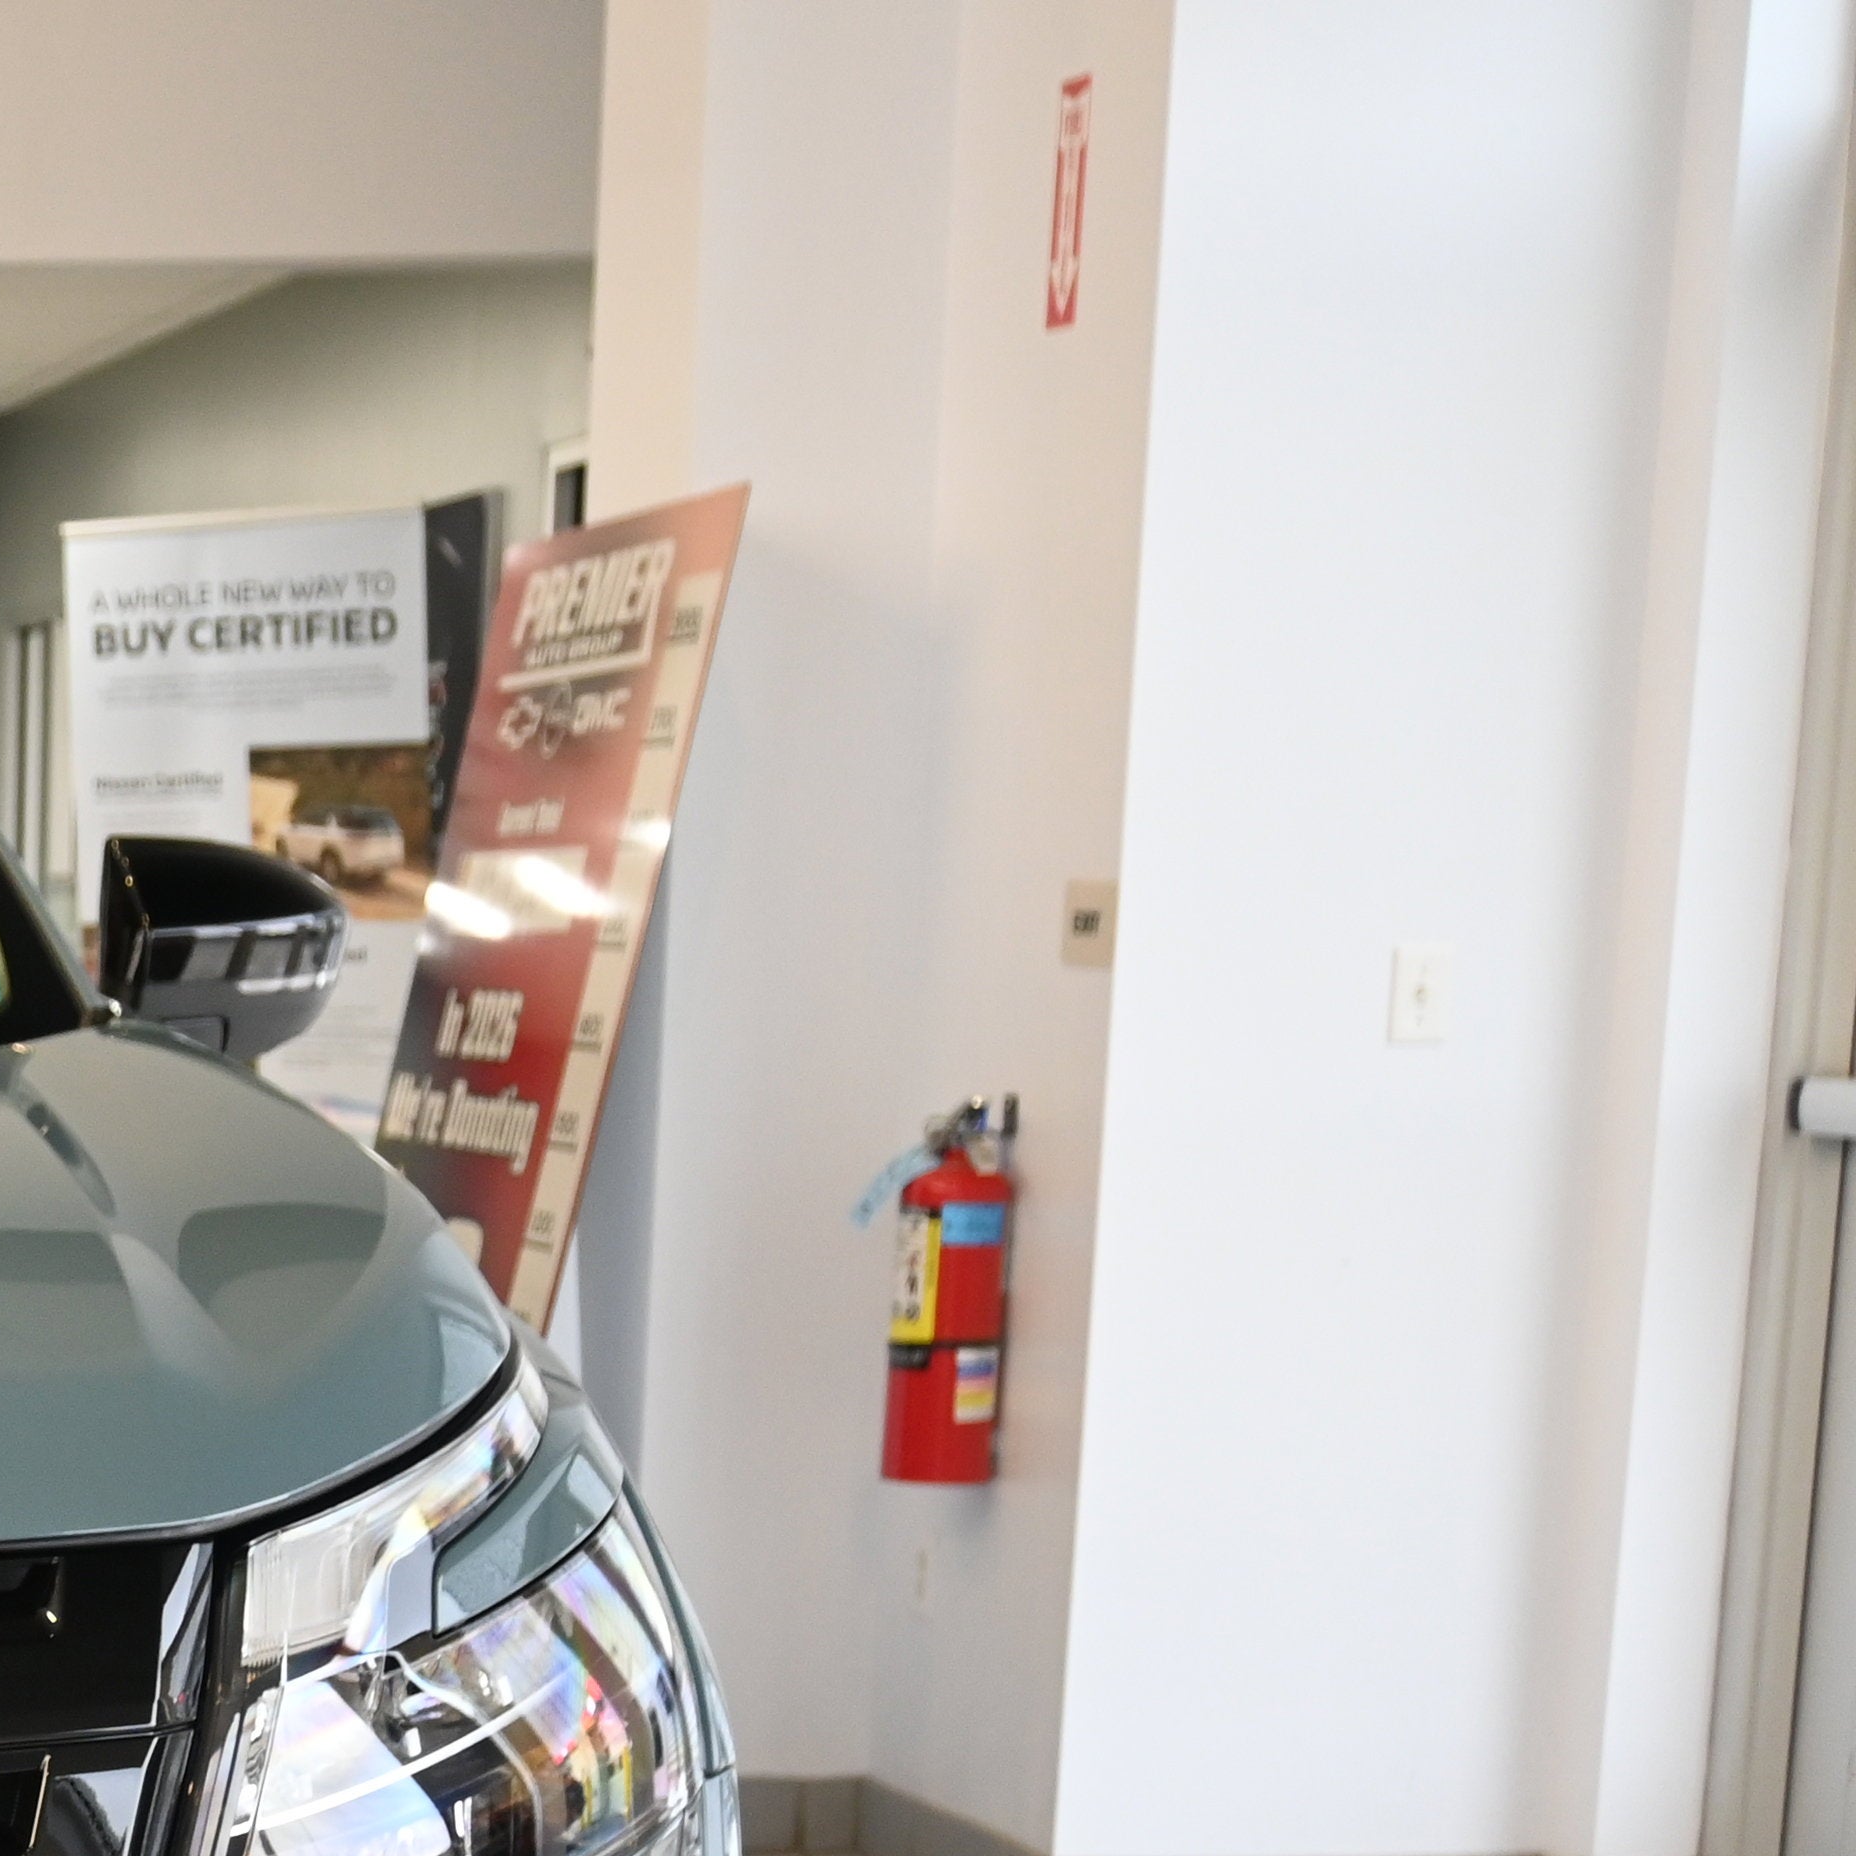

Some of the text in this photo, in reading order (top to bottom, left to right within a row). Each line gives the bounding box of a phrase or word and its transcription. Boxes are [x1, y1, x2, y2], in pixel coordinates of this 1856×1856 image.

[92, 571, 396, 611] A WHOLE NEW WAY TO
[511, 538, 676, 647] PREMIER
[94, 607, 398, 657] BUY CERTIFIED
[569, 630, 623, 658] GROUP
[442, 1077, 540, 1176] Donating
